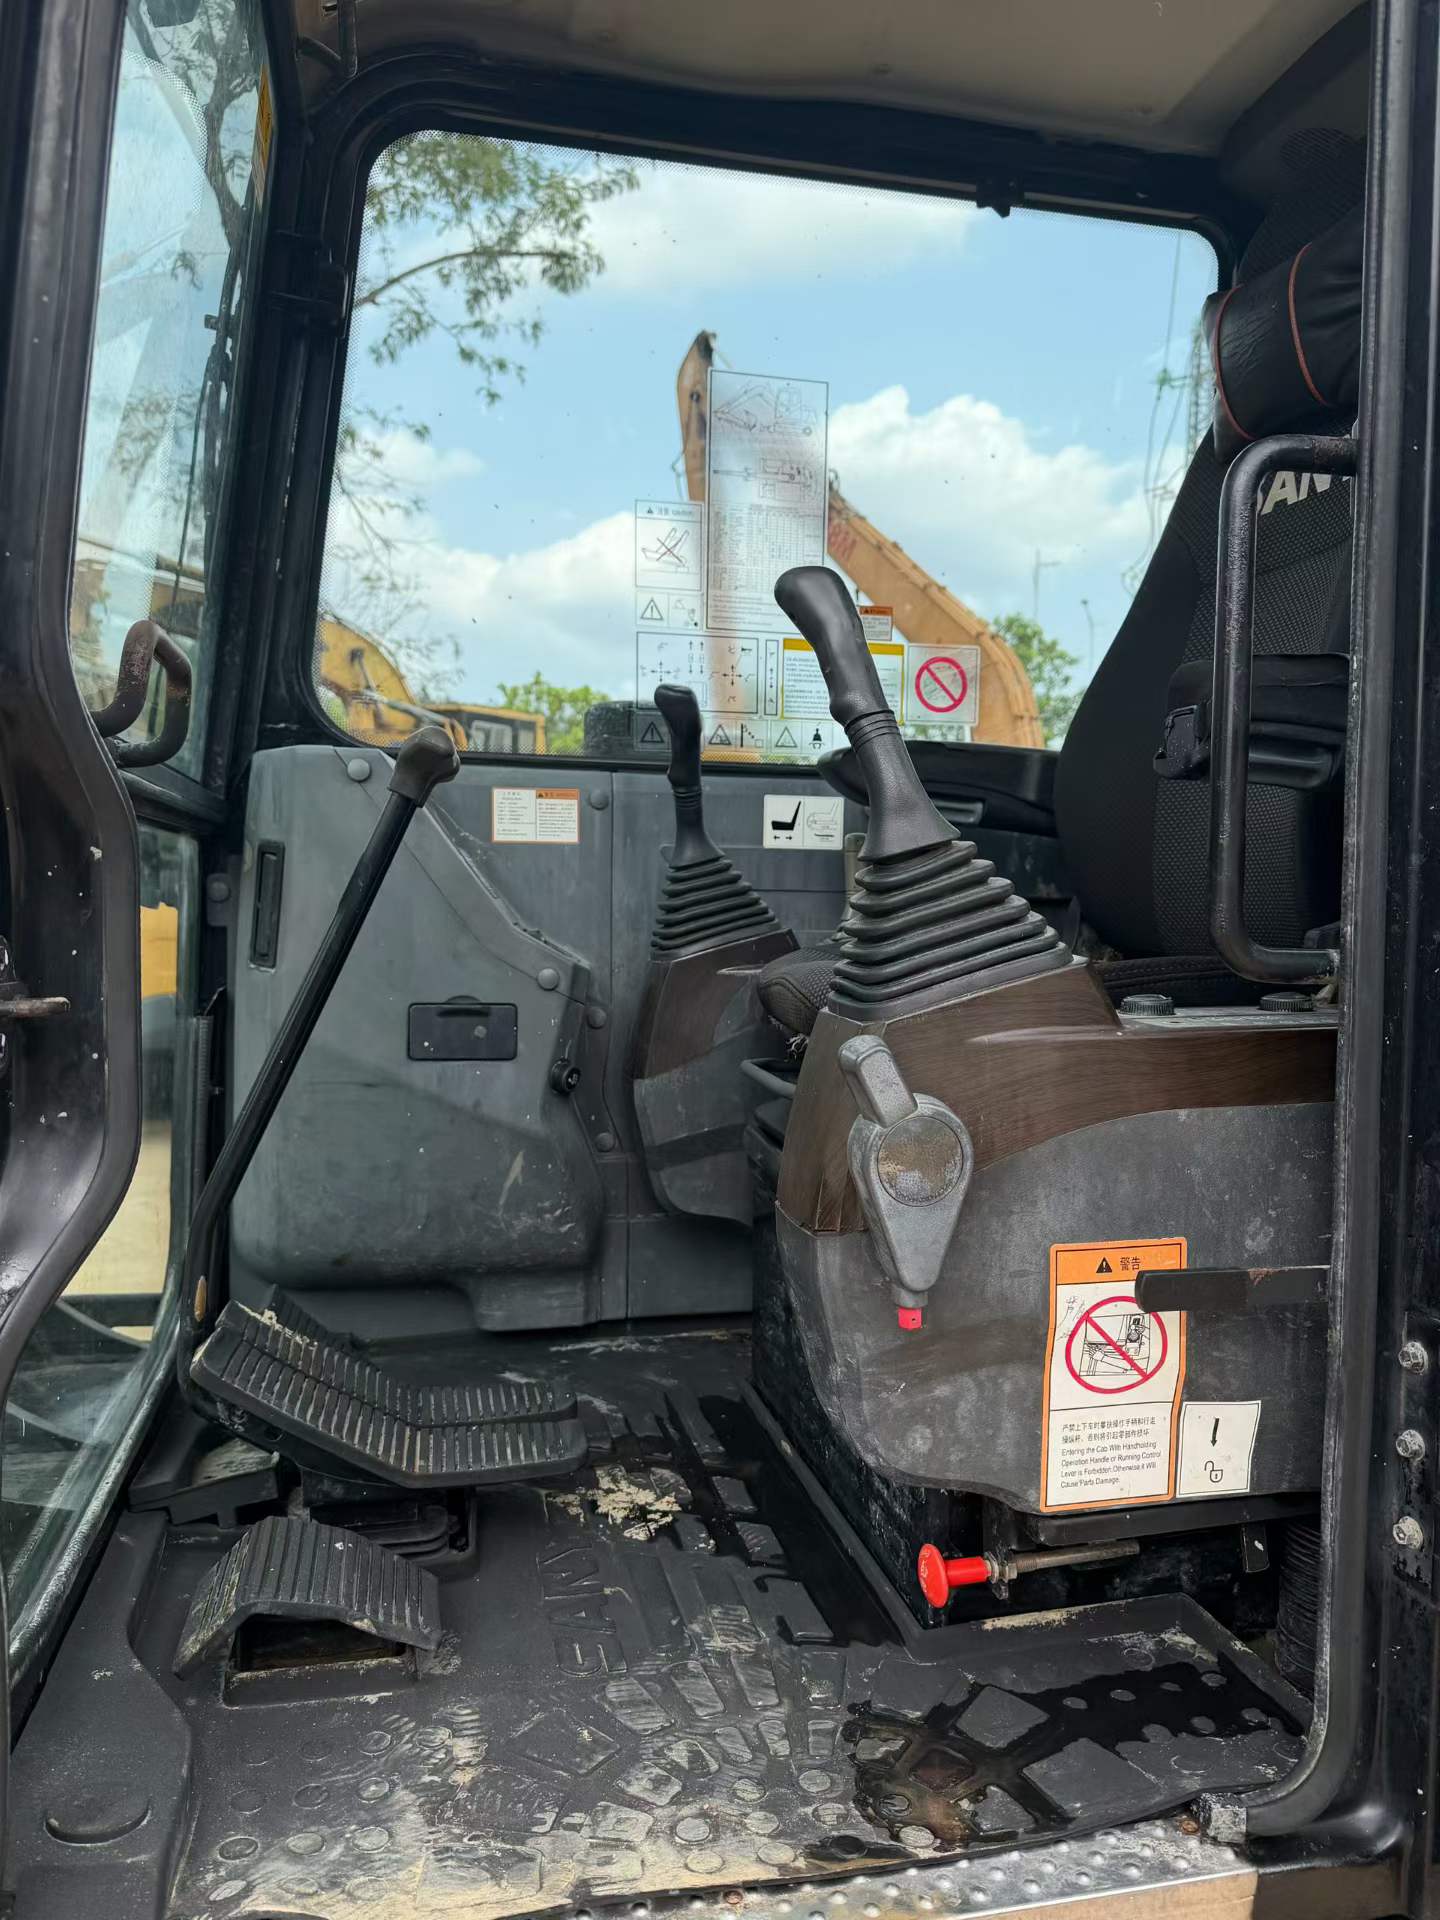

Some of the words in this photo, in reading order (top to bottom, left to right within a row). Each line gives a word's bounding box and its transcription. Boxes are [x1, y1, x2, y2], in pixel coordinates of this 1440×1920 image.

[1119, 1256, 1141, 1271] 警告
[1061, 1448, 1085, 1456] Entering
[1096, 1445, 1108, 1453] Cab
[1122, 1442, 1156, 1450] Handholding
[1061, 1458, 1089, 1467] Operation
[1090, 1455, 1109, 1464] Handle
[1118, 1453, 1140, 1461] Running
[1141, 1450, 1161, 1459] Control
[1061, 1470, 1076, 1478] Lever
[1060, 1480, 1078, 1489] Cause
[1079, 1478, 1094, 1487] Parts
[1095, 1477, 1120, 1485] Damage.
